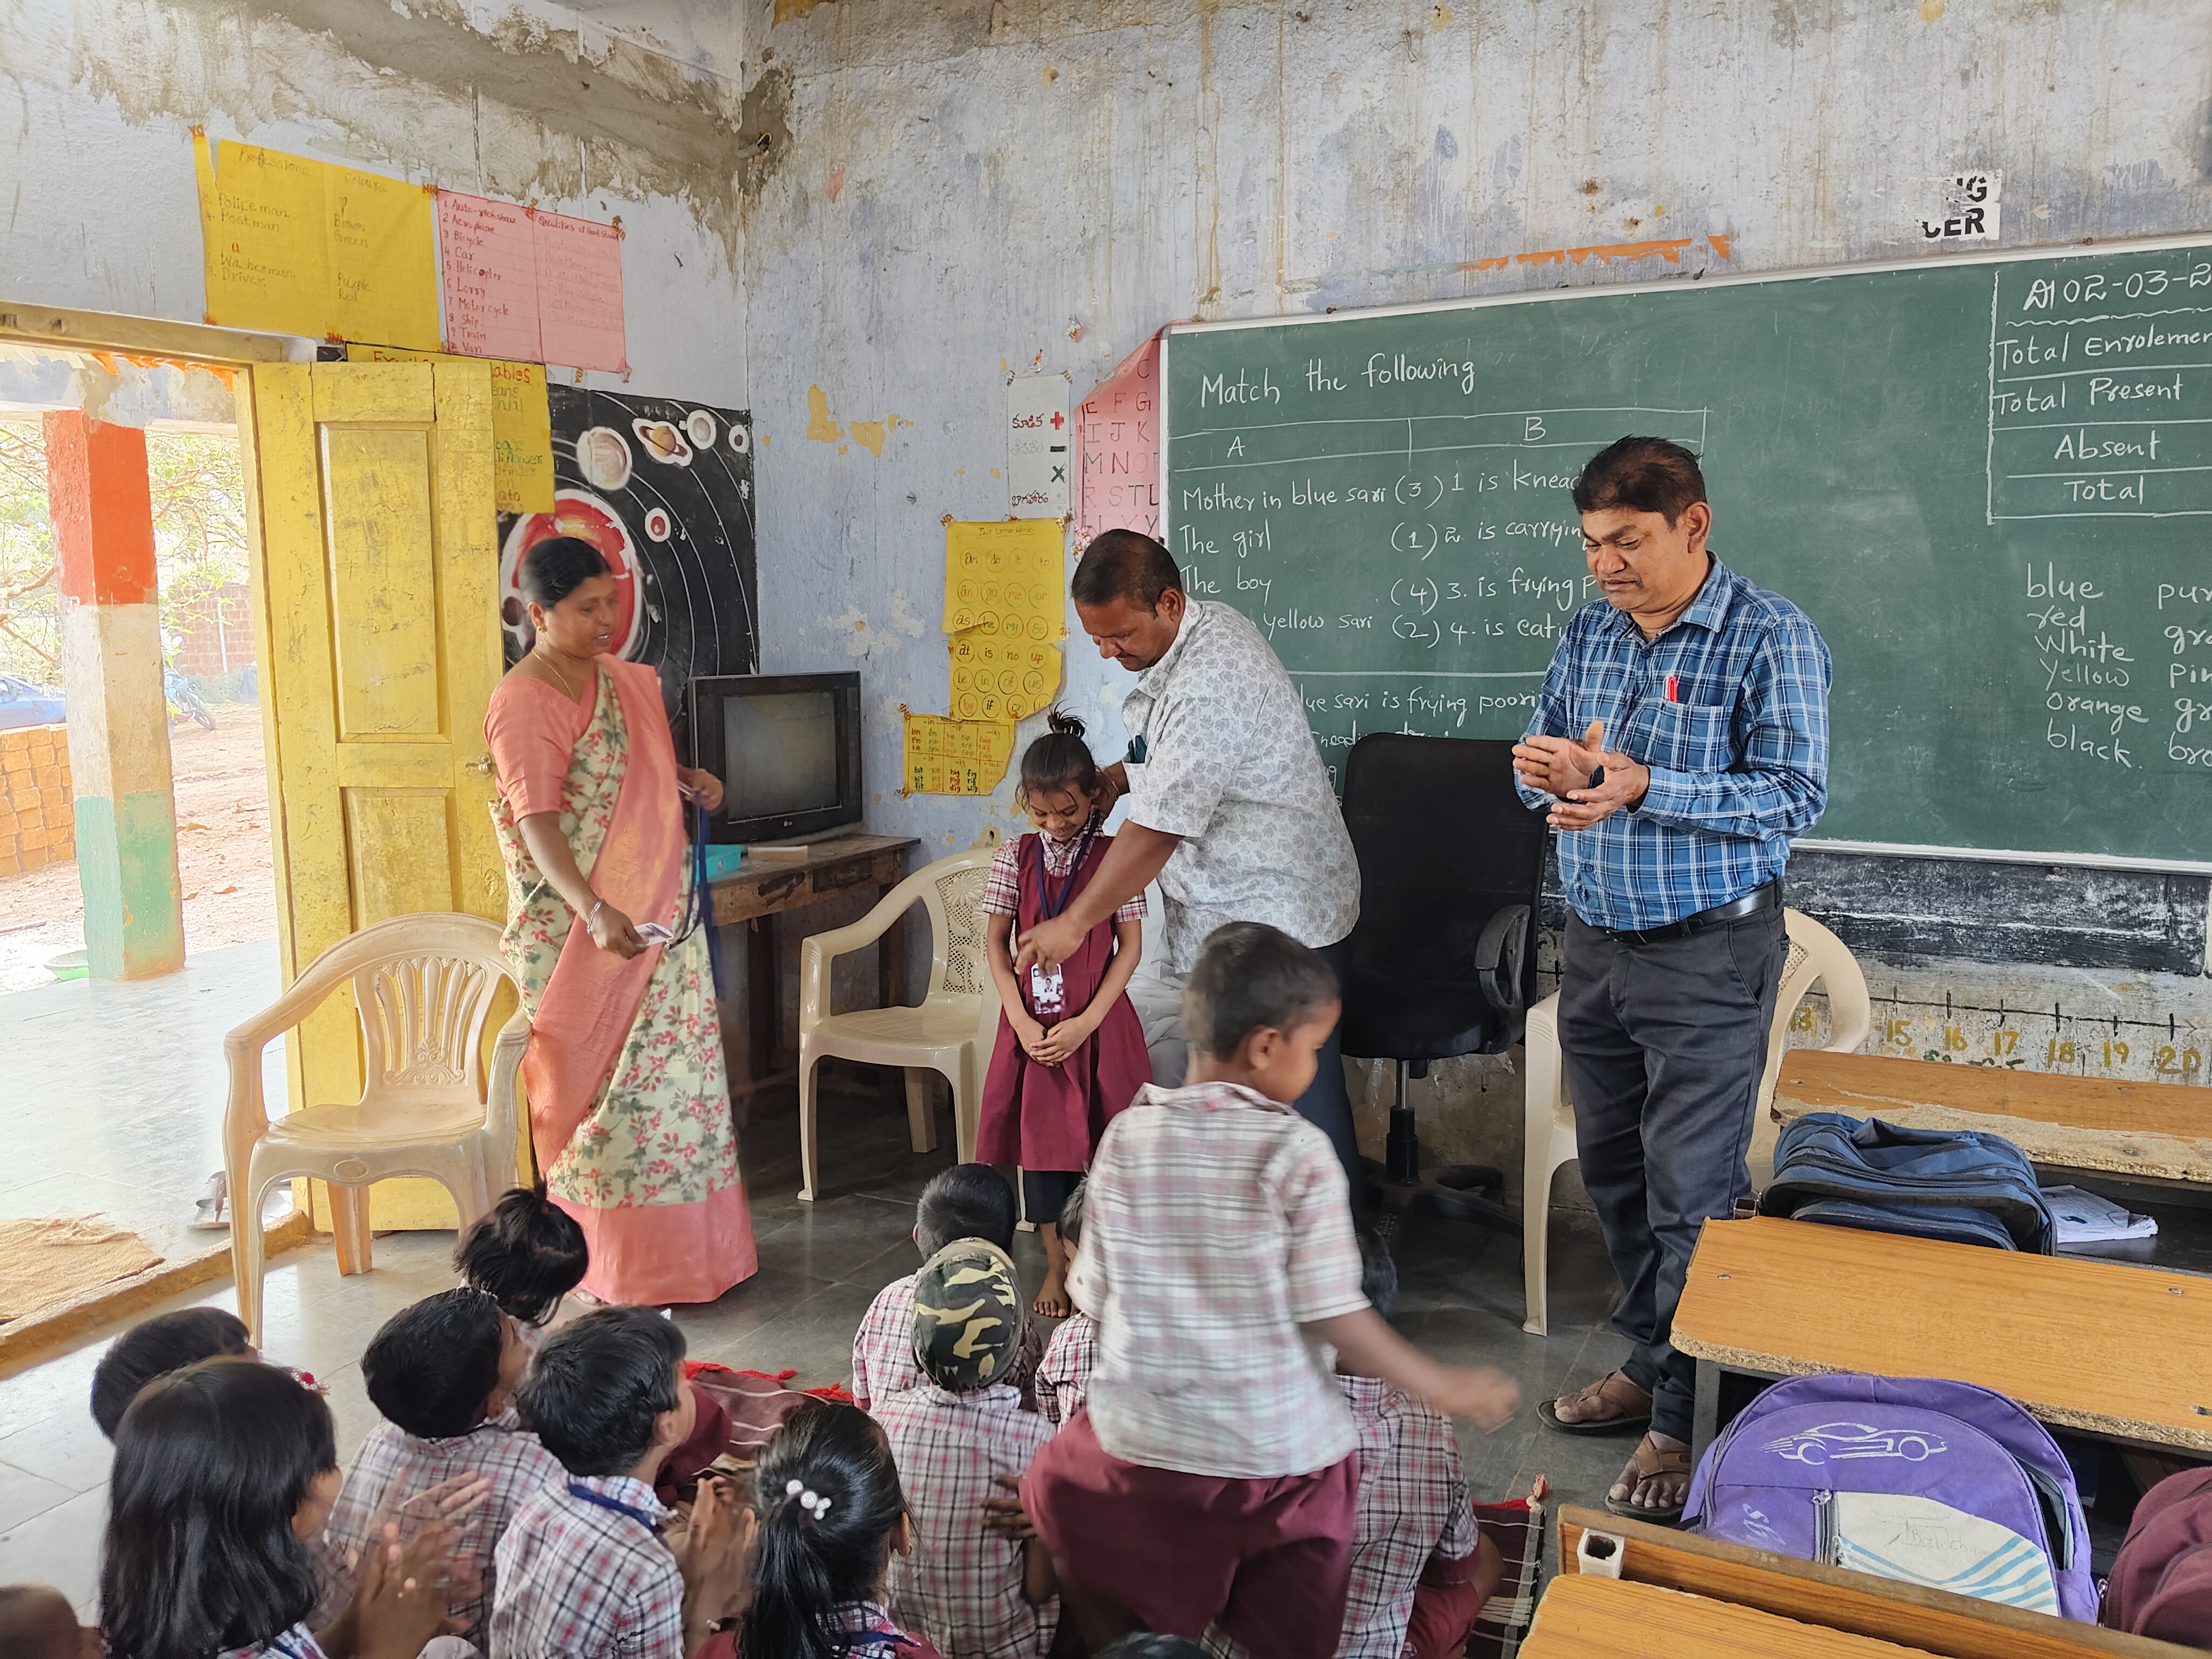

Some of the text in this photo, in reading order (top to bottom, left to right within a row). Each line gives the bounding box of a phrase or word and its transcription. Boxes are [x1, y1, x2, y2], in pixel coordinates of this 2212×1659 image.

[454, 230, 484, 248] Bicycle
[455, 246, 475, 261] Car
[457, 276, 485, 299] Lorry
[2063, 263, 2212, 303] 02-03-2
[462, 342, 482, 354] Van
[1997, 331, 2069, 372] Total
[1137, 359, 1149, 379] C
[1201, 352, 1475, 408] Match the following
[1114, 392, 1151, 414] F G
[1993, 374, 2183, 415] Total Present
[1086, 421, 1150, 443] I J K
[1522, 416, 1546, 441] B
[1227, 435, 1245, 458] A
[2054, 428, 2161, 461] Absent
[1085, 451, 1149, 474] M N O
[1183, 482, 1255, 511] Mother
[1263, 491, 1282, 510] in
[1292, 478, 1338, 506] blue
[1345, 487, 1387, 503] sari
[1479, 472, 1498, 493] is
[2063, 475, 2143, 504] Total
[1084, 484, 1144, 508] R S T
[1178, 524, 1219, 554] The
[1232, 518, 1271, 558] girl
[1478, 521, 1496, 540] is
[965, 552, 1050, 567] am do it to
[961, 585, 1048, 601] an go me or
[1179, 564, 1221, 594] The
[1237, 565, 1272, 606] boy
[1478, 576, 1497, 597] is
[1507, 567, 1574, 611] frying
[2027, 561, 2103, 601] blue
[2159, 584, 2212, 610] pur
[956, 615, 970, 625] as
[982, 616, 994, 629] he
[1006, 622, 1019, 635] my
[1263, 608, 1324, 642] yellow
[1338, 613, 1373, 630] sari
[1485, 618, 1505, 636] is
[1517, 613, 1563, 639] eati
[2027, 605, 2085, 636] red
[959, 644, 1044, 664] at is no up
[957, 673, 1041, 689] be in of us
[963, 699, 973, 714] by
[986, 700, 994, 711] if
[1300, 683, 1542, 727] lue sari is frying poori
[2047, 718, 2132, 768] black
[1886, 1020, 1913, 1047] 15
[1944, 1026, 1968, 1051] 16
[1994, 1031, 2020, 1056] 17
[2047, 1038, 2076, 1067] 18
[2105, 1039, 2130, 1068] 19
[2157, 1046, 2202, 1075] 20
